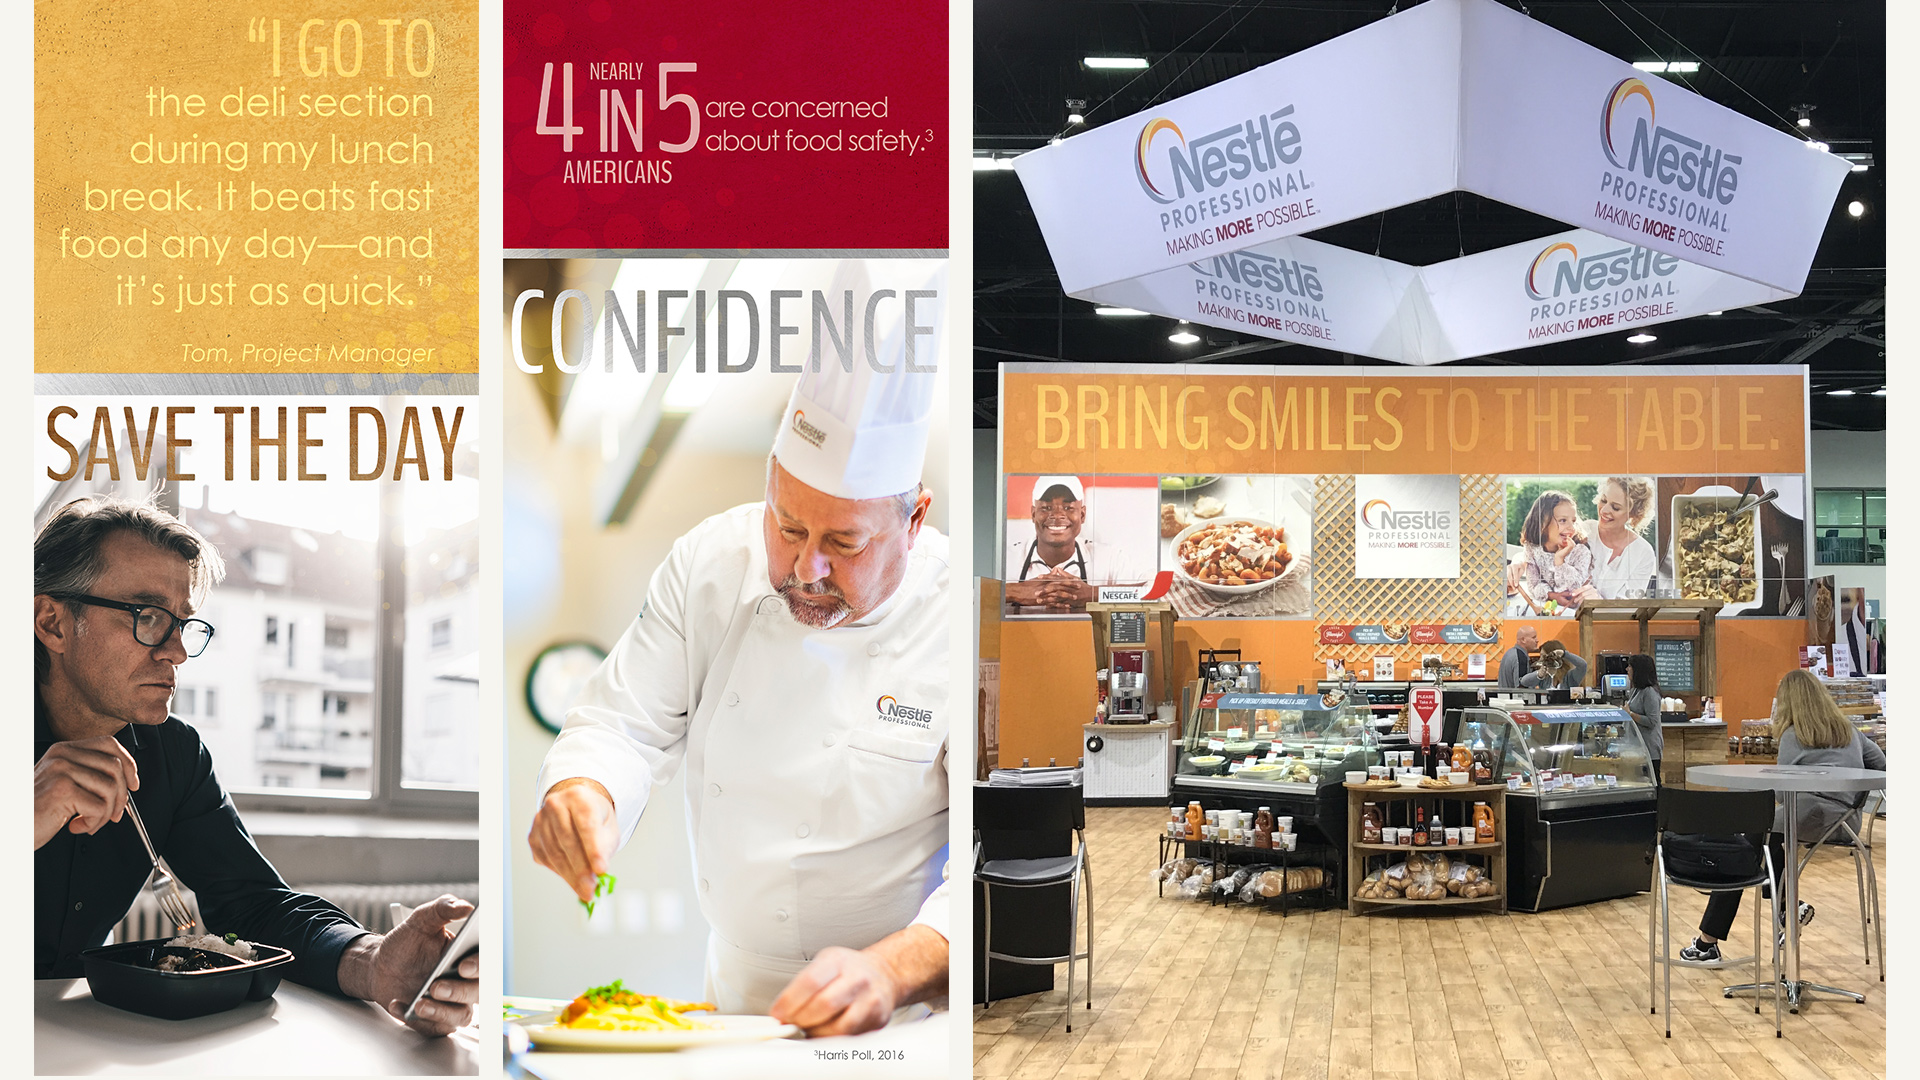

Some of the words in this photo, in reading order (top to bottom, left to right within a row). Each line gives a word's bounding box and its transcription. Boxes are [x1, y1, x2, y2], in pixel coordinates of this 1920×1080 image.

[300, 18, 363, 78] GO
[378, 18, 436, 78] TO
[589, 62, 644, 81] NEARLY
[146, 86, 206, 117] the
[220, 86, 286, 117] deli
[298, 86, 433, 117] section
[535, 62, 584, 153] 4
[599, 89, 643, 153] IN
[658, 62, 700, 154] 5
[705, 101, 746, 118] are
[751, 96, 888, 118] concerned
[130, 133, 249, 171] during
[262, 140, 318, 171] my
[331, 133, 433, 164] lunch
[705, 129, 779, 152] about
[785, 129, 842, 152] food
[563, 160, 673, 184] AMERICANS
[84, 180, 202, 211] break.
[217, 180, 237, 211] It
[251, 180, 355, 211] beats
[368, 180, 434, 211] fast
[1160, 169, 1314, 232] PROFESSIONAL
[1601, 172, 1729, 233] PROFESSIONAL
[1166, 229, 1214, 256] MAKING
[1215, 217, 1255, 242] MORE
[1594, 201, 1641, 230] MAKING
[1642, 217, 1677, 242] MORE
[59, 227, 147, 259] food
[161, 235, 231, 265] any
[117, 274, 165, 306] it’s
[175, 274, 237, 313] just
[249, 282, 290, 306] as
[302, 274, 433, 312] quick.”
[1195, 279, 1331, 323] PROFESSIONAL
[1530, 281, 1677, 322] PROFESSIONAL
[511, 288, 938, 374] CONFIDENCE
[1198, 301, 1245, 323] MAKING
[1247, 312, 1282, 330] MORE
[1528, 320, 1574, 340] MAKING
[1577, 313, 1614, 331] MORE
[181, 343, 233, 363] Tom,
[241, 343, 322, 367] Project
[328, 343, 436, 367] Manager
[1037, 385, 1209, 450] BRING
[1225, 386, 1403, 452] SMILES
[1417, 387, 1480, 452] TO
[1496, 387, 1592, 452] THE
[1607, 387, 1779, 452] TABLE.
[47, 405, 196, 482] SAVE
[213, 405, 327, 482] THE
[348, 405, 465, 482] DAY
[1368, 532, 1450, 540] PROFESSIONAL
[1625, 589, 1682, 599] COFFEE
[878, 715, 931, 730] PROFESSIONAL
[852, 1049, 874, 1061] Poll,
[877, 1049, 904, 1060] 2016
